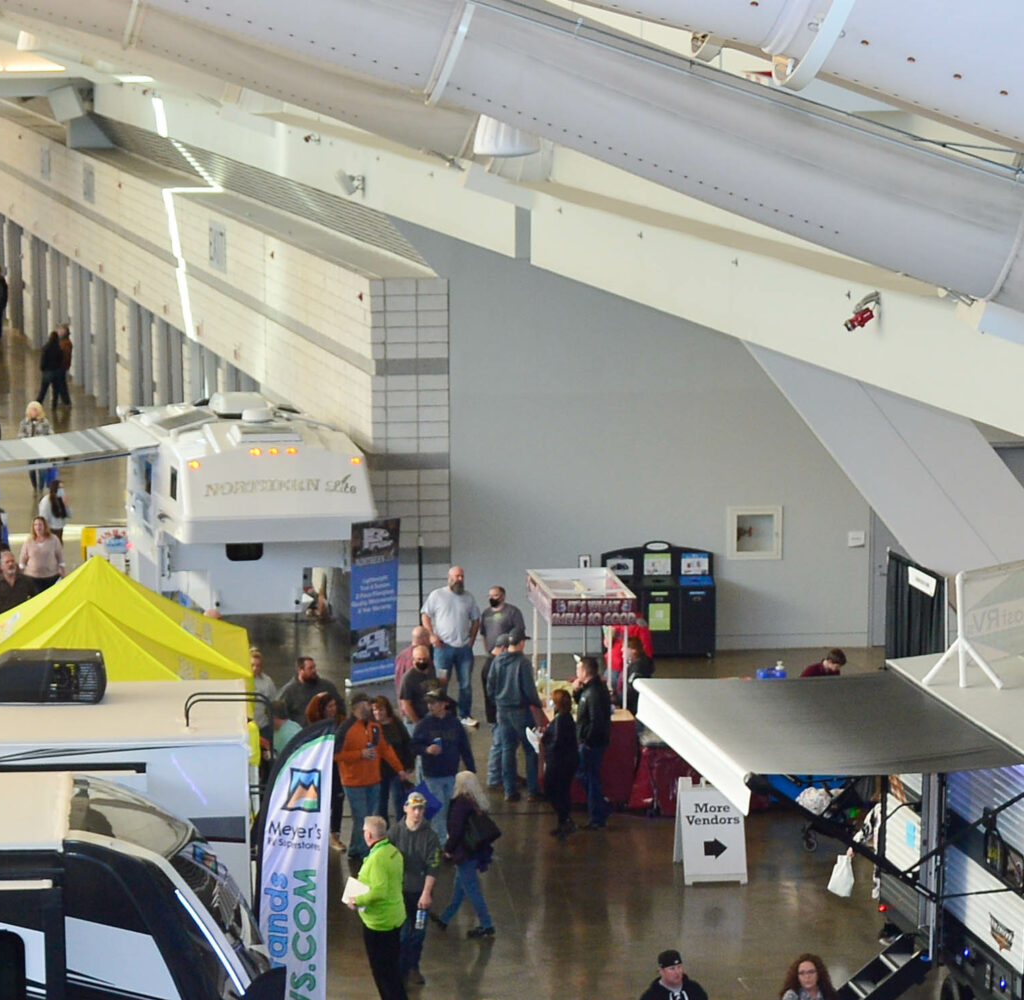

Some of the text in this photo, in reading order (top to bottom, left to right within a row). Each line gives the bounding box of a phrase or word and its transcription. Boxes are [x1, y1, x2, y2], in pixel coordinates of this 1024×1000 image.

[588, 600, 621, 613] WHAT
[603, 612, 637, 625] GOOD
[694, 803, 730, 813] More
[685, 815, 740, 825] Vendors
[268, 821, 322, 841] Meyer's
[263, 871, 288, 968] rands
